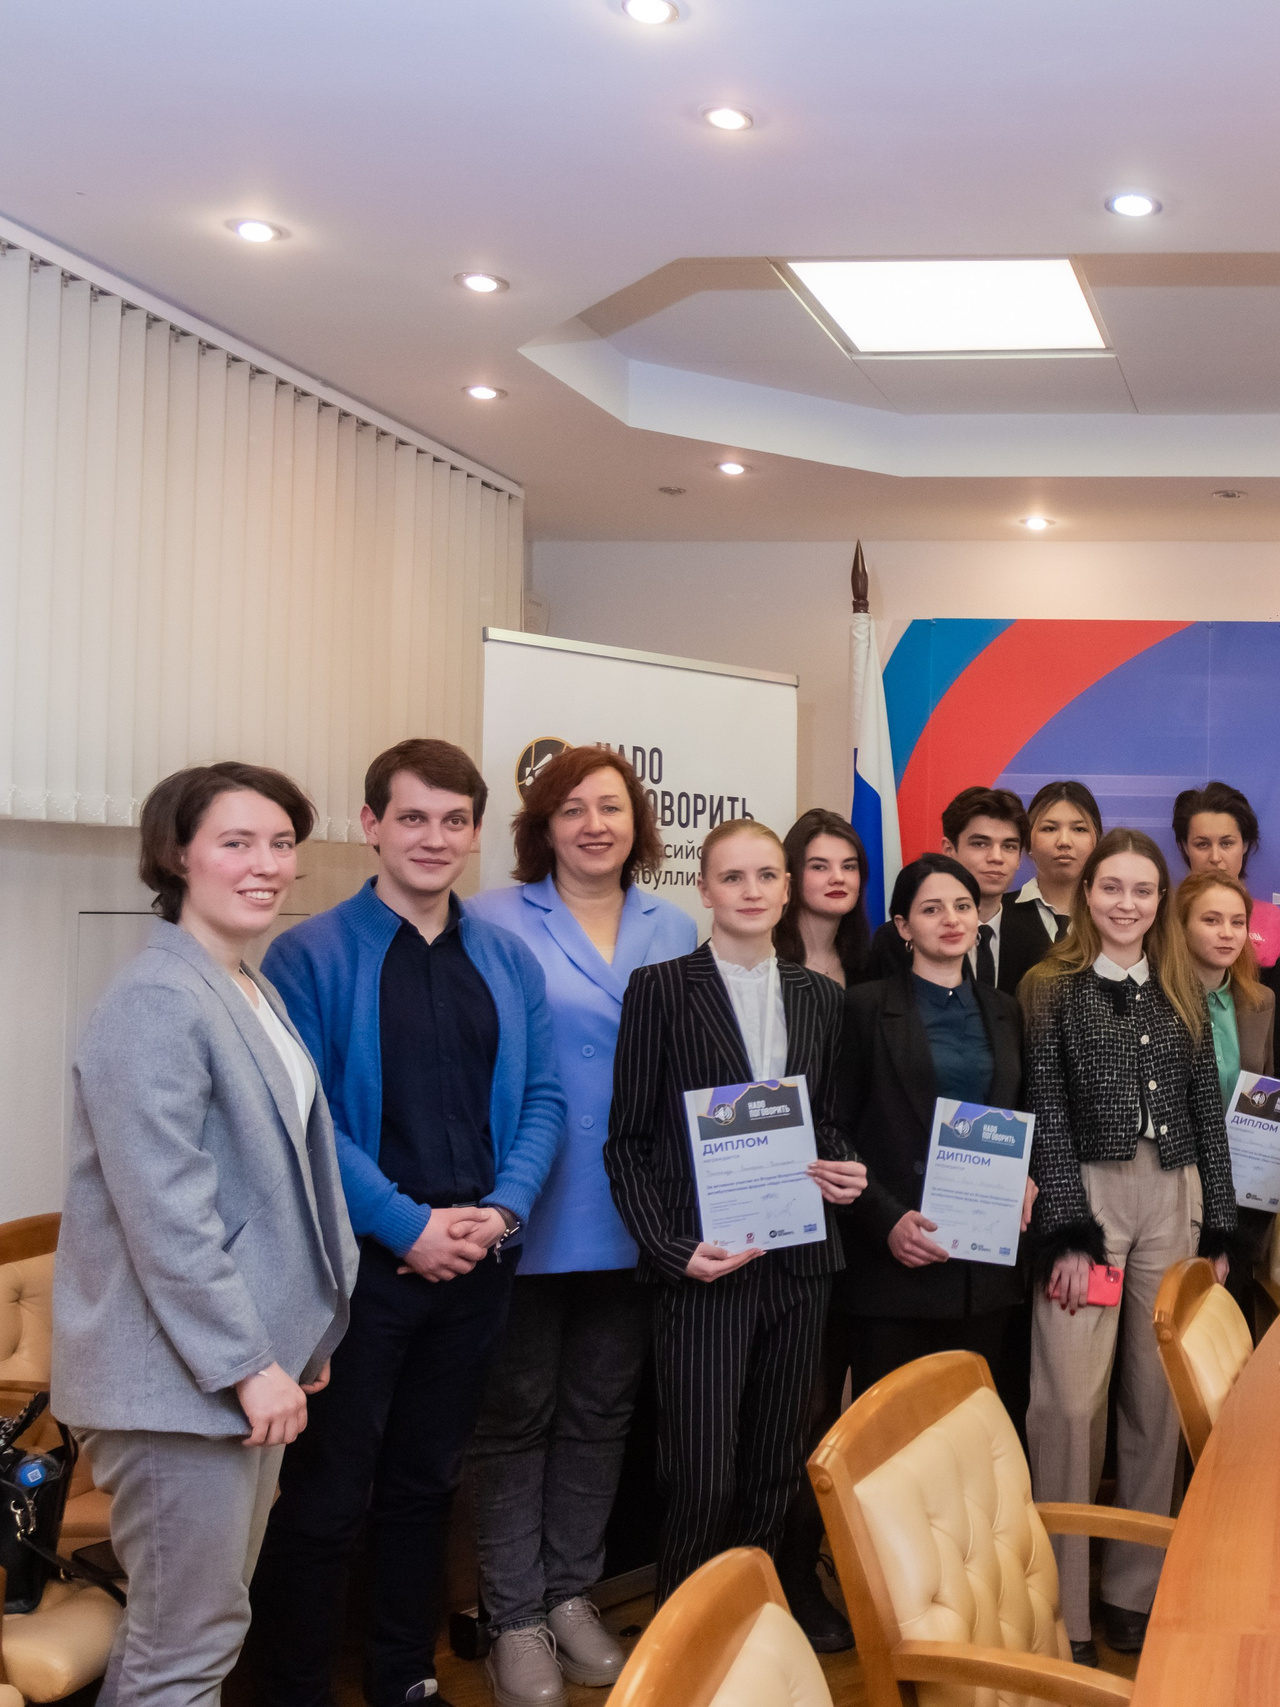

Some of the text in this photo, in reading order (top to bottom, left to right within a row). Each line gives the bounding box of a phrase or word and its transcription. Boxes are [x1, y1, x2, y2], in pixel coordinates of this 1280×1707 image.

[1230, 1114, 1279, 1133] ДИПЛОМ
[702, 1135, 769, 1156] ДИПЛОМ
[936, 1149, 991, 1167] ДИПЛОМ
